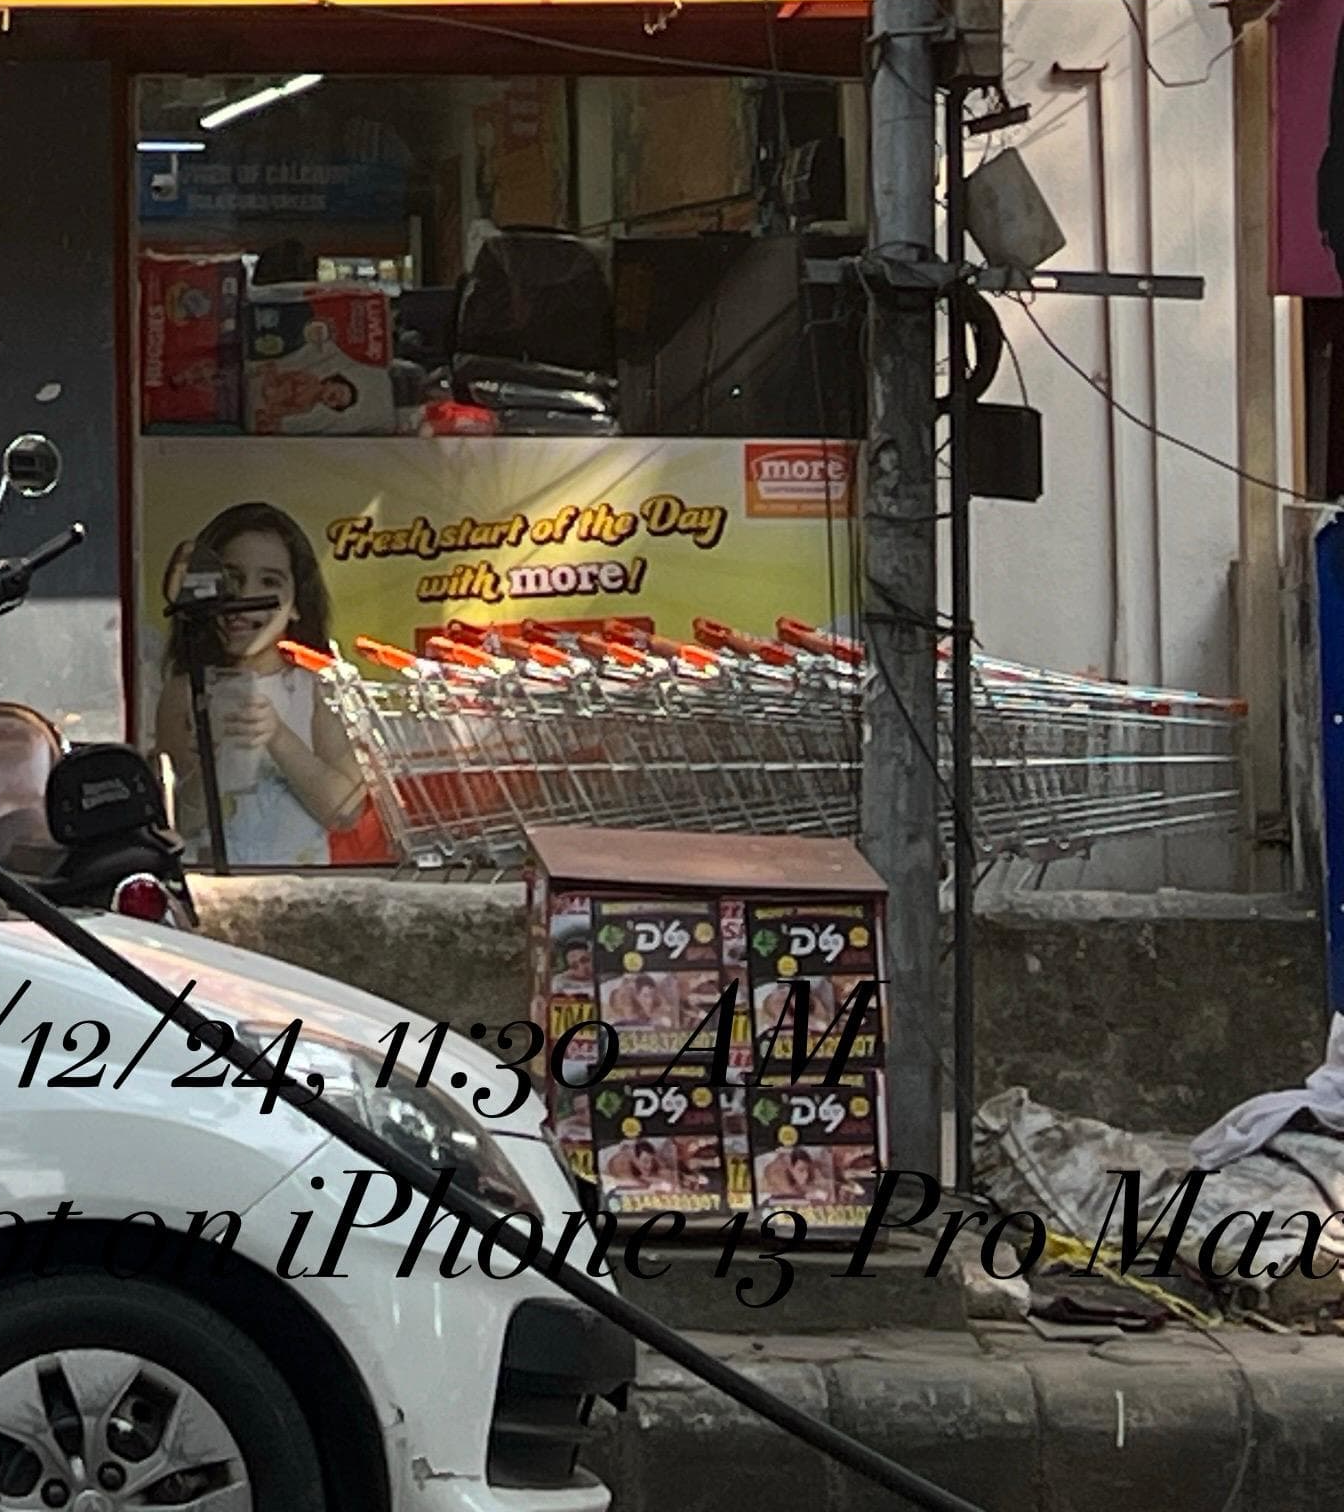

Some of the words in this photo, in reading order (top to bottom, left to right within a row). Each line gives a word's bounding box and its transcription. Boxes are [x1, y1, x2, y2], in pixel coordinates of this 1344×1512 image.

[759, 459, 844, 480] more
[327, 517, 439, 560] Fresh
[436, 512, 529, 553] start
[529, 508, 572, 546] of
[574, 502, 638, 544] the
[640, 494, 729, 550] Day
[417, 560, 502, 605] with
